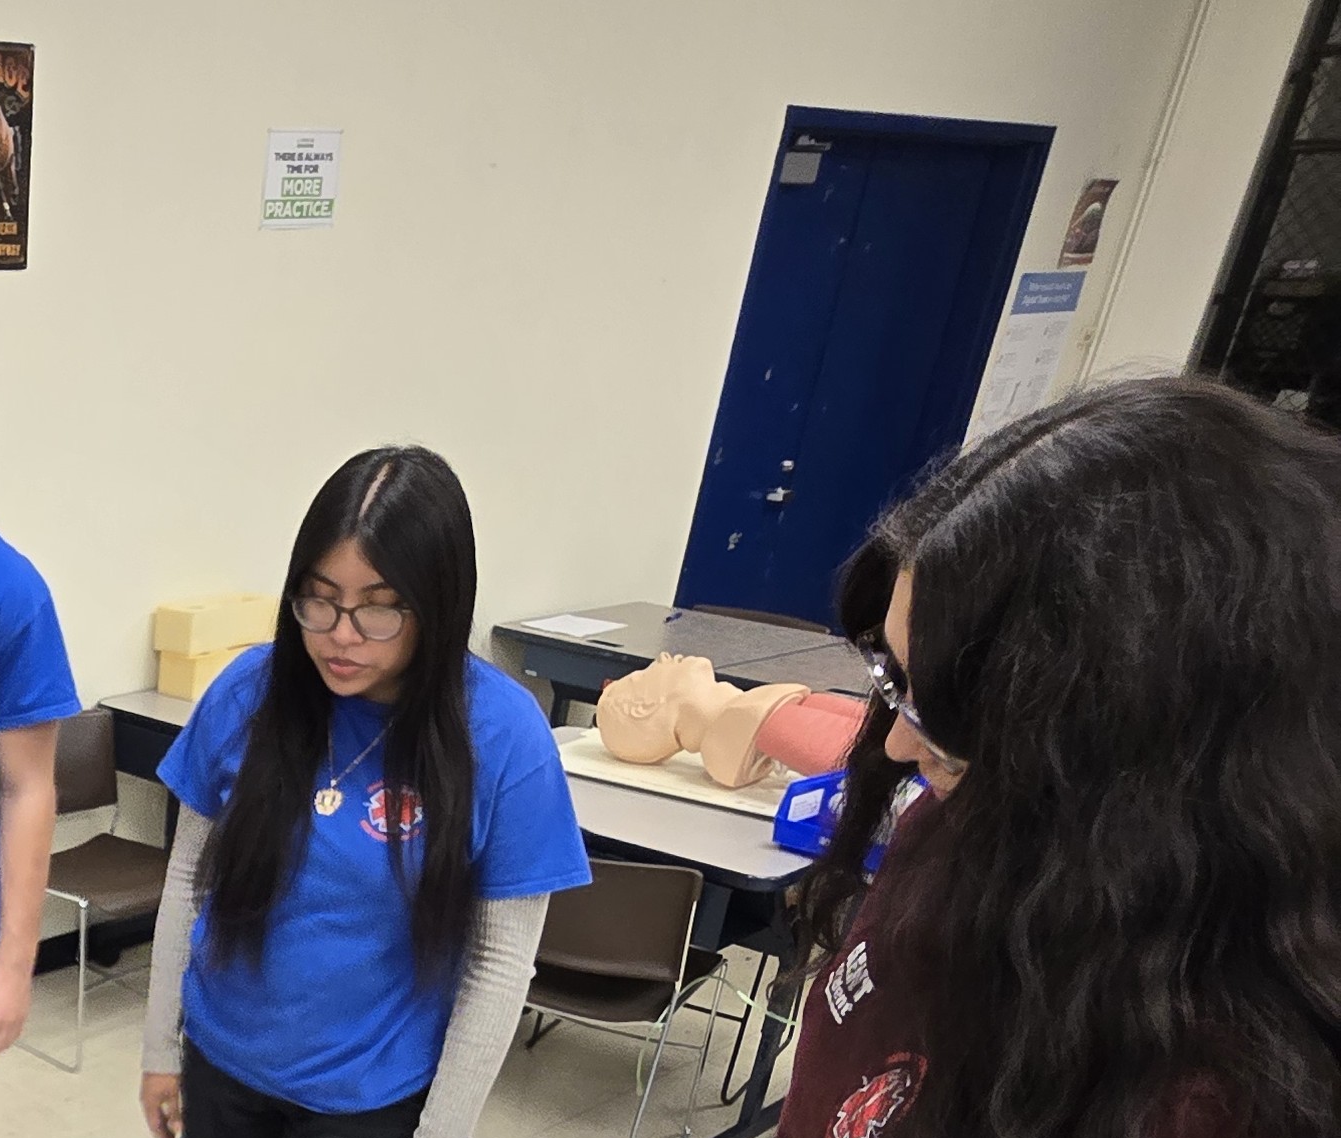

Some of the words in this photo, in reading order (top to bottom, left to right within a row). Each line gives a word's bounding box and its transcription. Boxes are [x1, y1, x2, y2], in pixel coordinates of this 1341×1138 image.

[274, 152, 296, 161] THERE
[297, 152, 304, 161] IS
[305, 152, 333, 161] ALWAYS
[286, 164, 303, 174] TIME
[304, 164, 319, 174] FOR
[282, 179, 321, 195] MORE
[831, 962, 853, 1016] dent
